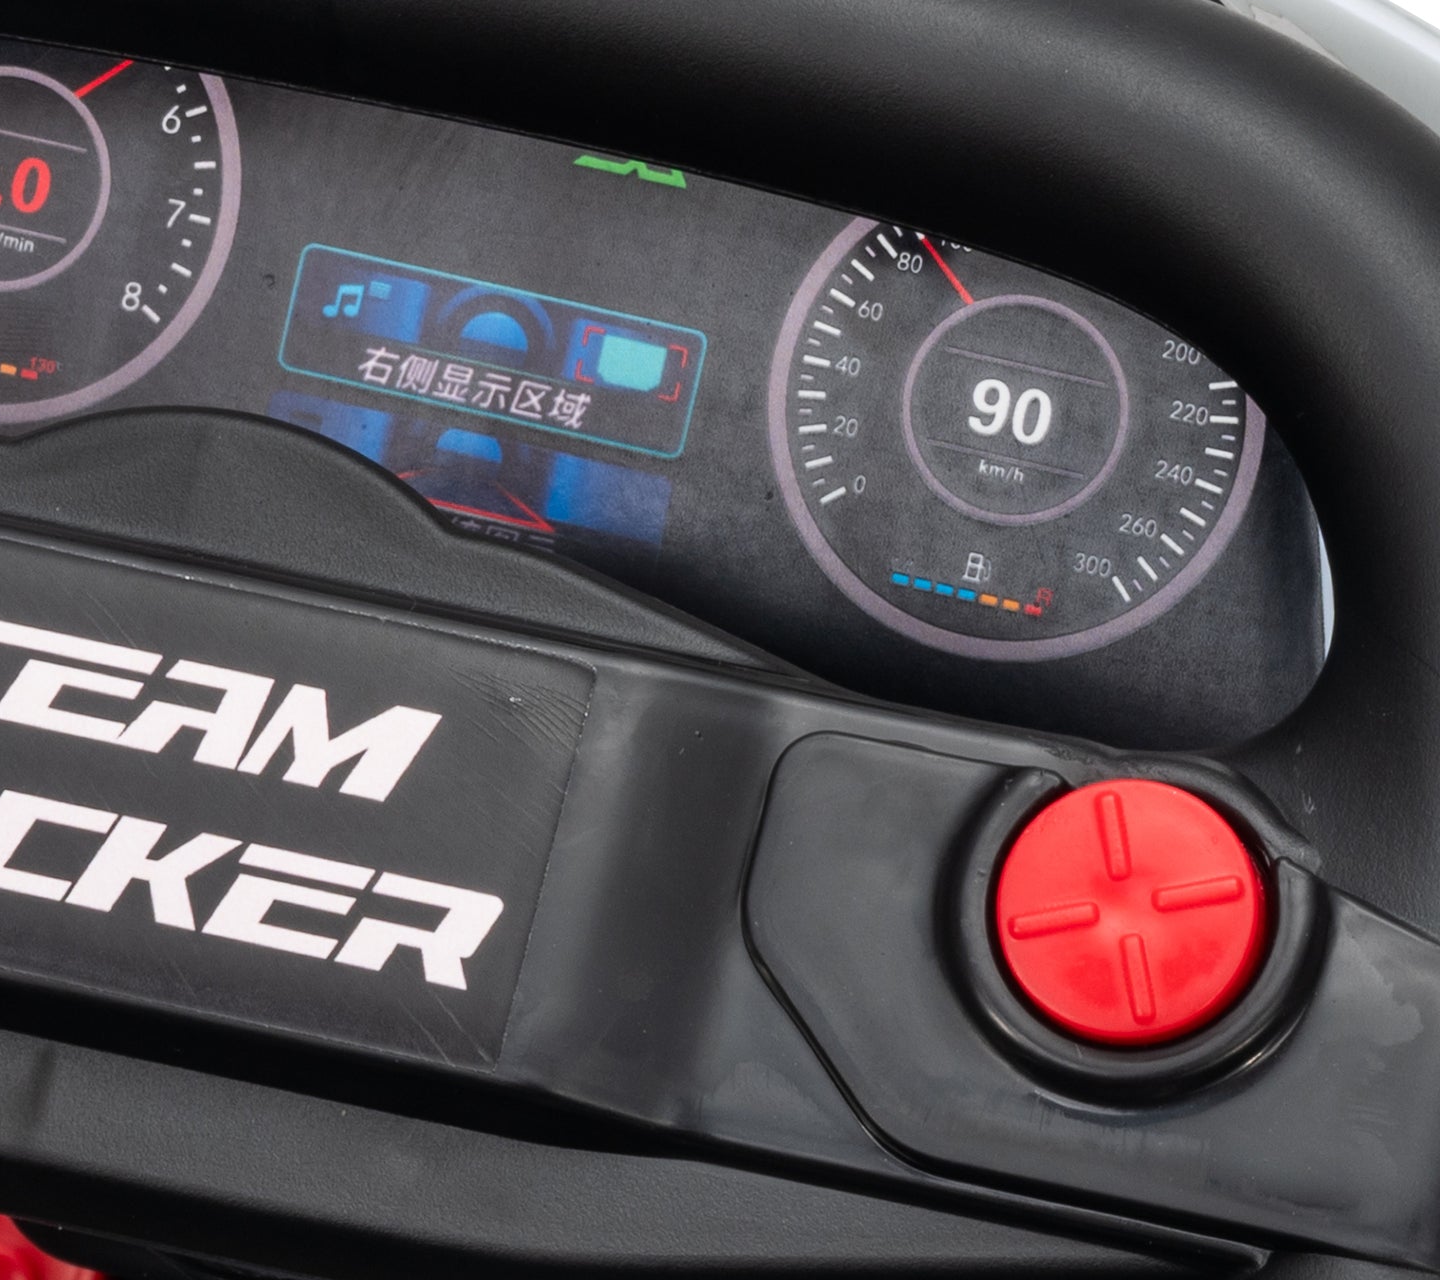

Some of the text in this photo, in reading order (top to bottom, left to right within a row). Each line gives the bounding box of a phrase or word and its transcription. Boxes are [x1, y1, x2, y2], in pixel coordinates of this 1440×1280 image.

[162, 105, 182, 135] 6
[167, 198, 187, 229] 7
[896, 252, 923, 274] 80
[121, 282, 143, 312] 8
[858, 300, 884, 322] 60
[1162, 340, 1200, 365] 200
[834, 355, 862, 377] 40
[357, 346, 592, 430] 右侧显示区域
[967, 378, 1052, 445] 90
[1169, 400, 1208, 426] 220
[832, 415, 859, 437] 20
[978, 458, 1025, 484] km/h
[1154, 459, 1193, 486] 240
[854, 475, 867, 495] 0
[1118, 513, 1158, 539] 260
[1072, 552, 1112, 579] 300
